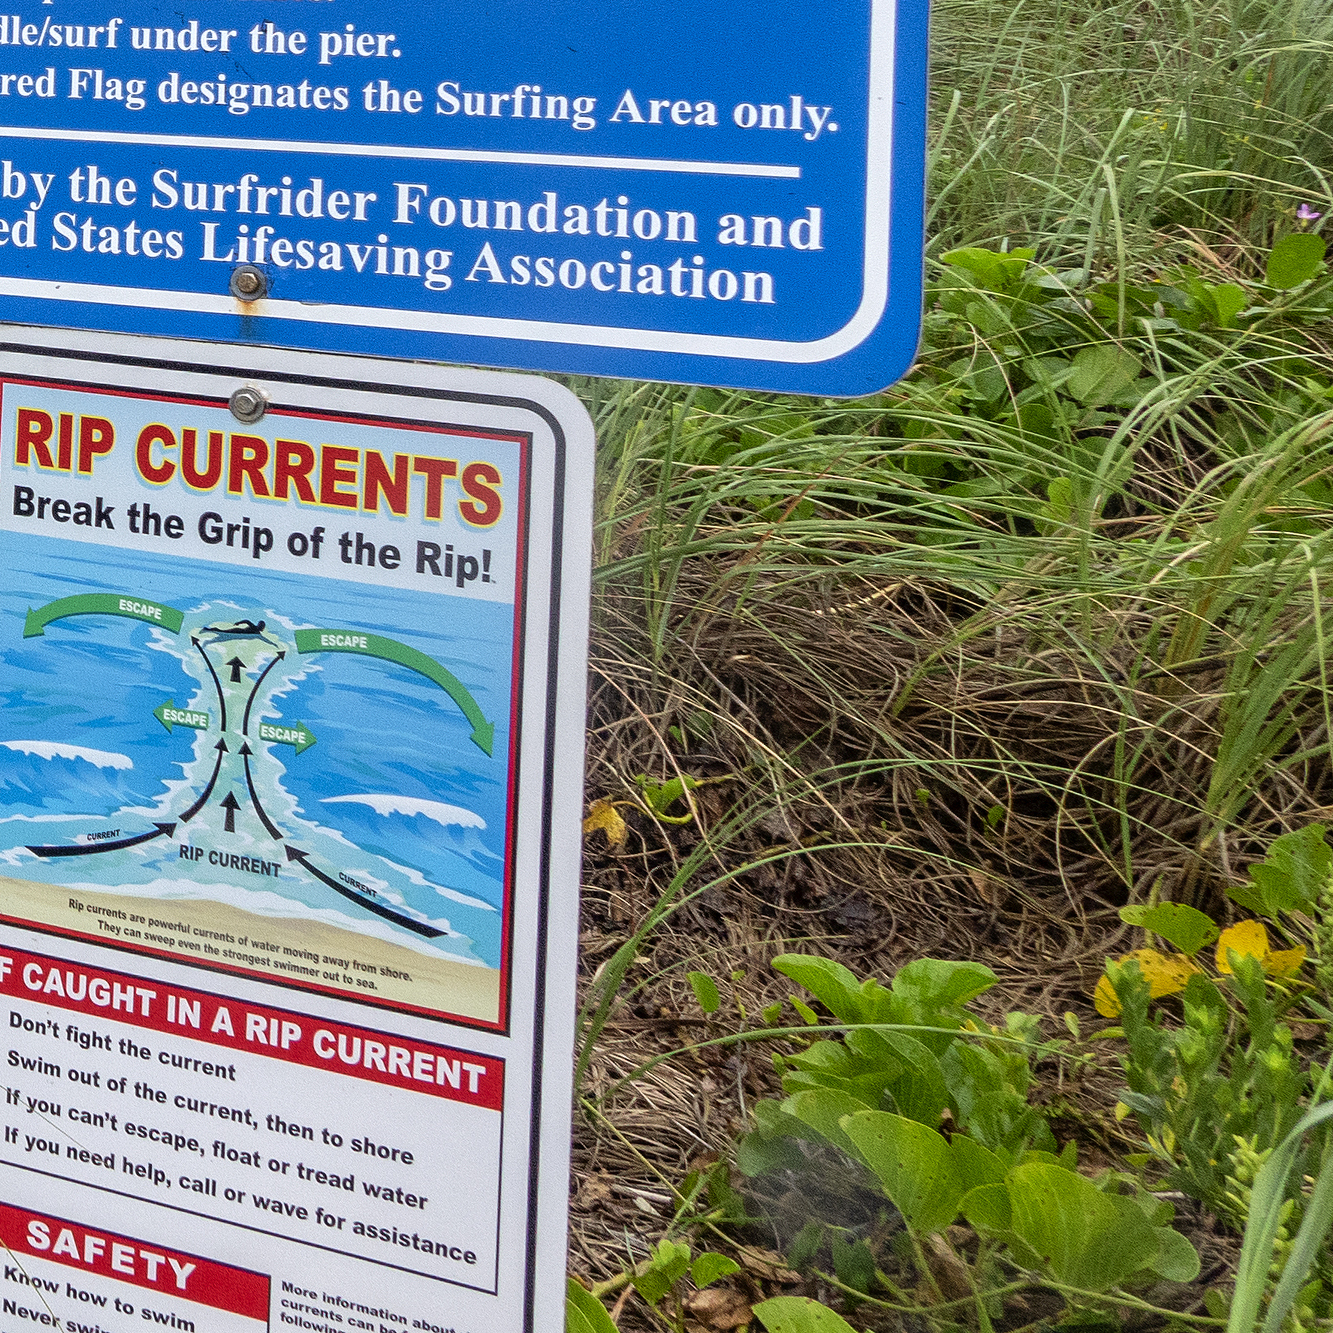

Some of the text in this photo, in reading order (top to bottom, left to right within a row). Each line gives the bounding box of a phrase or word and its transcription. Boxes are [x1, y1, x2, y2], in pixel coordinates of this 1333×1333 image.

[130, 20, 238, 52] under
[249, 22, 307, 55] the
[318, 23, 401, 65] pier.
[67, 68, 146, 111] Flag
[158, 72, 349, 115] designates
[362, 80, 423, 113] the
[436, 81, 597, 131] Surfing
[609, 89, 718, 126] Area
[733, 95, 838, 141] only.
[1, 160, 56, 211] by
[68, 165, 137, 206] the
[151, 169, 377, 221] Surfrider
[392, 182, 698, 242] Foundation
[717, 207, 824, 250] and
[52, 212, 184, 260] States
[199, 221, 453, 291] Lifesaving
[464, 241, 776, 304] Association
[15, 407, 501, 526] RIP CURRENTS
[13, 484, 491, 589] Break the Grip of the Rip!
[118, 599, 162, 620] ESCAPE
[321, 634, 368, 649] ESCAPE
[163, 709, 207, 728] ESCAPE
[260, 725, 306, 744] ESCAPE
[87, 828, 120, 841] CURRENT
[179, 844, 282, 878] RIP CURRENT
[338, 871, 378, 898] CURRENT
[68, 898, 413, 982] Rip currents are powerful currents of water moving away from shore.
[97, 919, 378, 990] They can sweep even the strongest swimmer out to sea.
[9, 1010, 236, 1082] Don't fight the current
[22, 962, 157, 1017] CAUGHT
[166, 994, 201, 1029] IN
[210, 1006, 235, 1037] A
[245, 1012, 302, 1050] RIP
[313, 1029, 486, 1094] CURRENT
[7, 1050, 414, 1165] Swim out of the current, then to shore
[26, 1220, 197, 1290] SAFETY
[2, 1298, 61, 1328] Never
[3, 1265, 195, 1332] Know how to swim
[280, 1298, 343, 1322] currents
[347, 1317, 375, 1332] can
[281, 1281, 318, 1299] More
[322, 1292, 408, 1325] information
